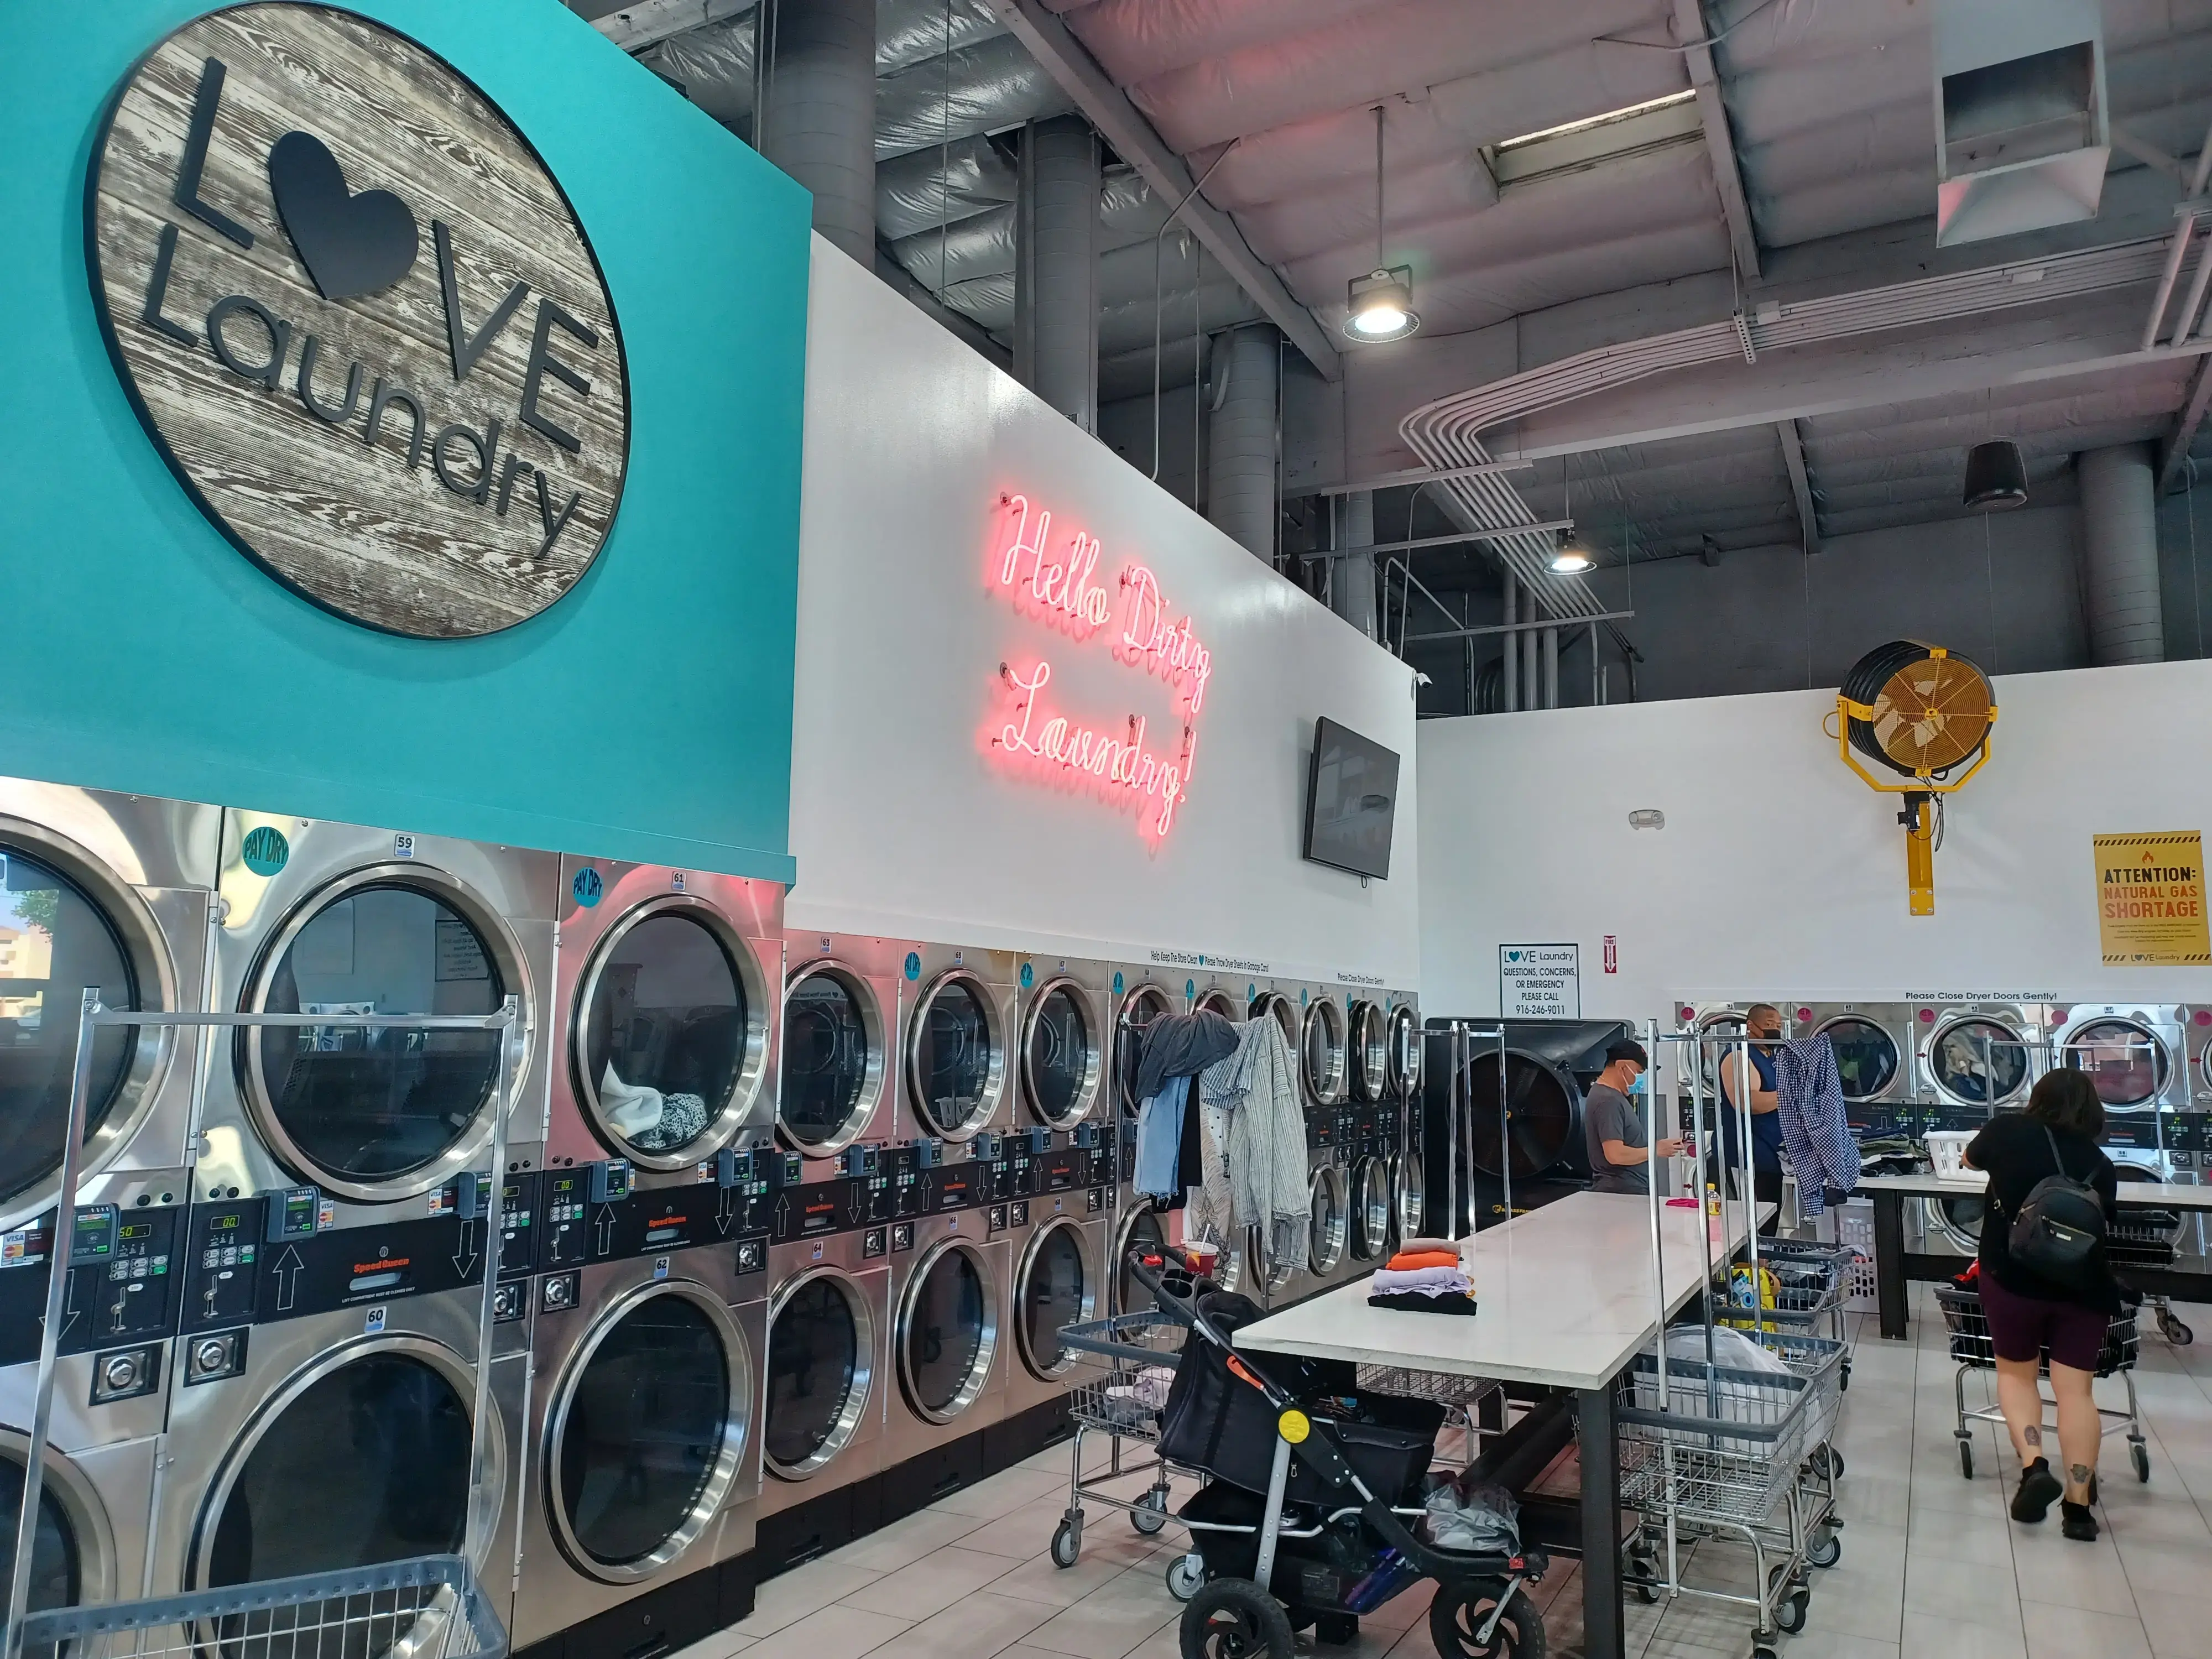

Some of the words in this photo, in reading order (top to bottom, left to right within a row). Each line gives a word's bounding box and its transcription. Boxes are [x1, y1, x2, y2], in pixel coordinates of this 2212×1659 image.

[142, 222, 581, 559] Laundry
[1001, 494, 1110, 626] Hello
[1123, 567, 1211, 713] Dirty
[244, 828, 267, 860] PAY
[265, 828, 289, 864] DRY
[398, 837, 413, 848] 59
[674, 873, 684, 883] 61
[2104, 867, 2196, 884] ATTENTION:
[573, 869, 587, 895] PAY
[588, 869, 603, 897] DRY
[2104, 886, 2164, 899] NATURAL
[2171, 885, 2198, 898] GAS
[2105, 901, 2198, 919] SHORTAGE
[822, 938, 830, 947] 63
[1151, 951, 1160, 962] Help
[1160, 952, 1170, 963] Keep
[1177, 953, 1187, 963] Store
[1187, 954, 1197, 964] Clean
[1205, 956, 1215, 966] Please
[1215, 957, 1225, 967] Throw
[1225, 958, 1234, 969] Dryer
[1247, 961, 1261, 973] Garbage
[1540, 952, 1573, 961] Laundry
[1504, 968, 1537, 977] QUESTIONS,
[1540, 968, 1576, 977] CONCERNS,
[1516, 980, 1525, 988] OR
[1527, 980, 1564, 989] EMERGENCY
[1966, 992, 1991, 1000] Dryer
[2023, 992, 2057, 1001] Gently!
[1516, 1005, 1564, 1014] 916-246-9011
[814, 1243, 821, 1252] 64
[353, 1261, 382, 1273] Speed
[382, 1259, 409, 1268] Queen
[657, 1259, 667, 1269] 62
[368, 1310, 383, 1322] 60
